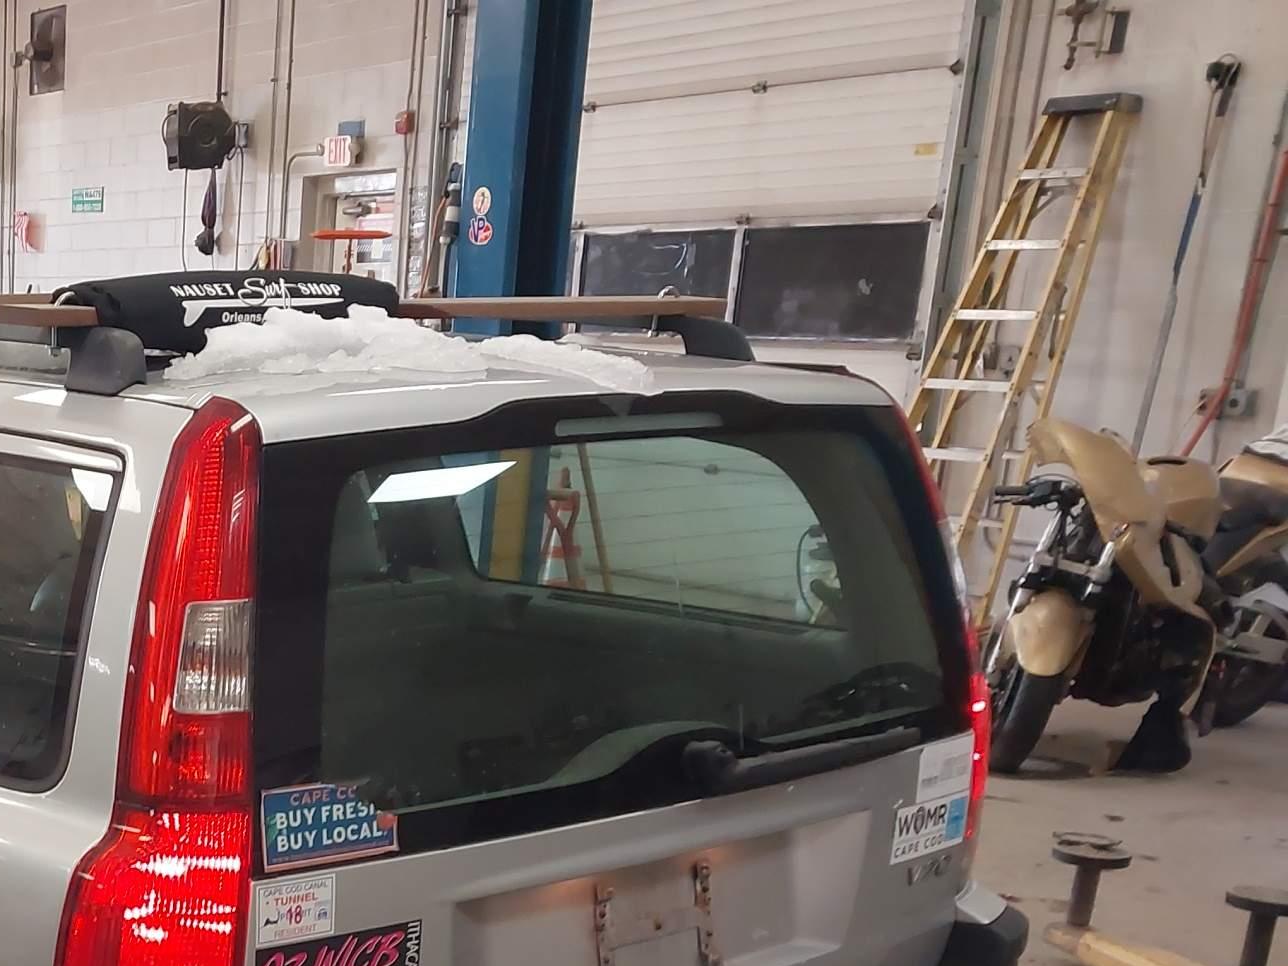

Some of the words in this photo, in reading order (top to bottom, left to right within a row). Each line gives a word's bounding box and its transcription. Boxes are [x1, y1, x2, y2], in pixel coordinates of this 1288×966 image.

[329, 138, 347, 164] EXIT
[170, 283, 235, 297] NAUSET
[237, 277, 297, 309] Surf
[297, 282, 342, 297] SHOP
[290, 788, 331, 806] CAPE
[275, 805, 317, 830] BUY
[898, 803, 948, 838] WOMR
[277, 828, 317, 852] BUY
[894, 840, 920, 858] CAPE
[924, 833, 944, 849] COD
[907, 856, 952, 886] V70
[273, 892, 318, 906] TUNNEL
[286, 904, 303, 925] 18
